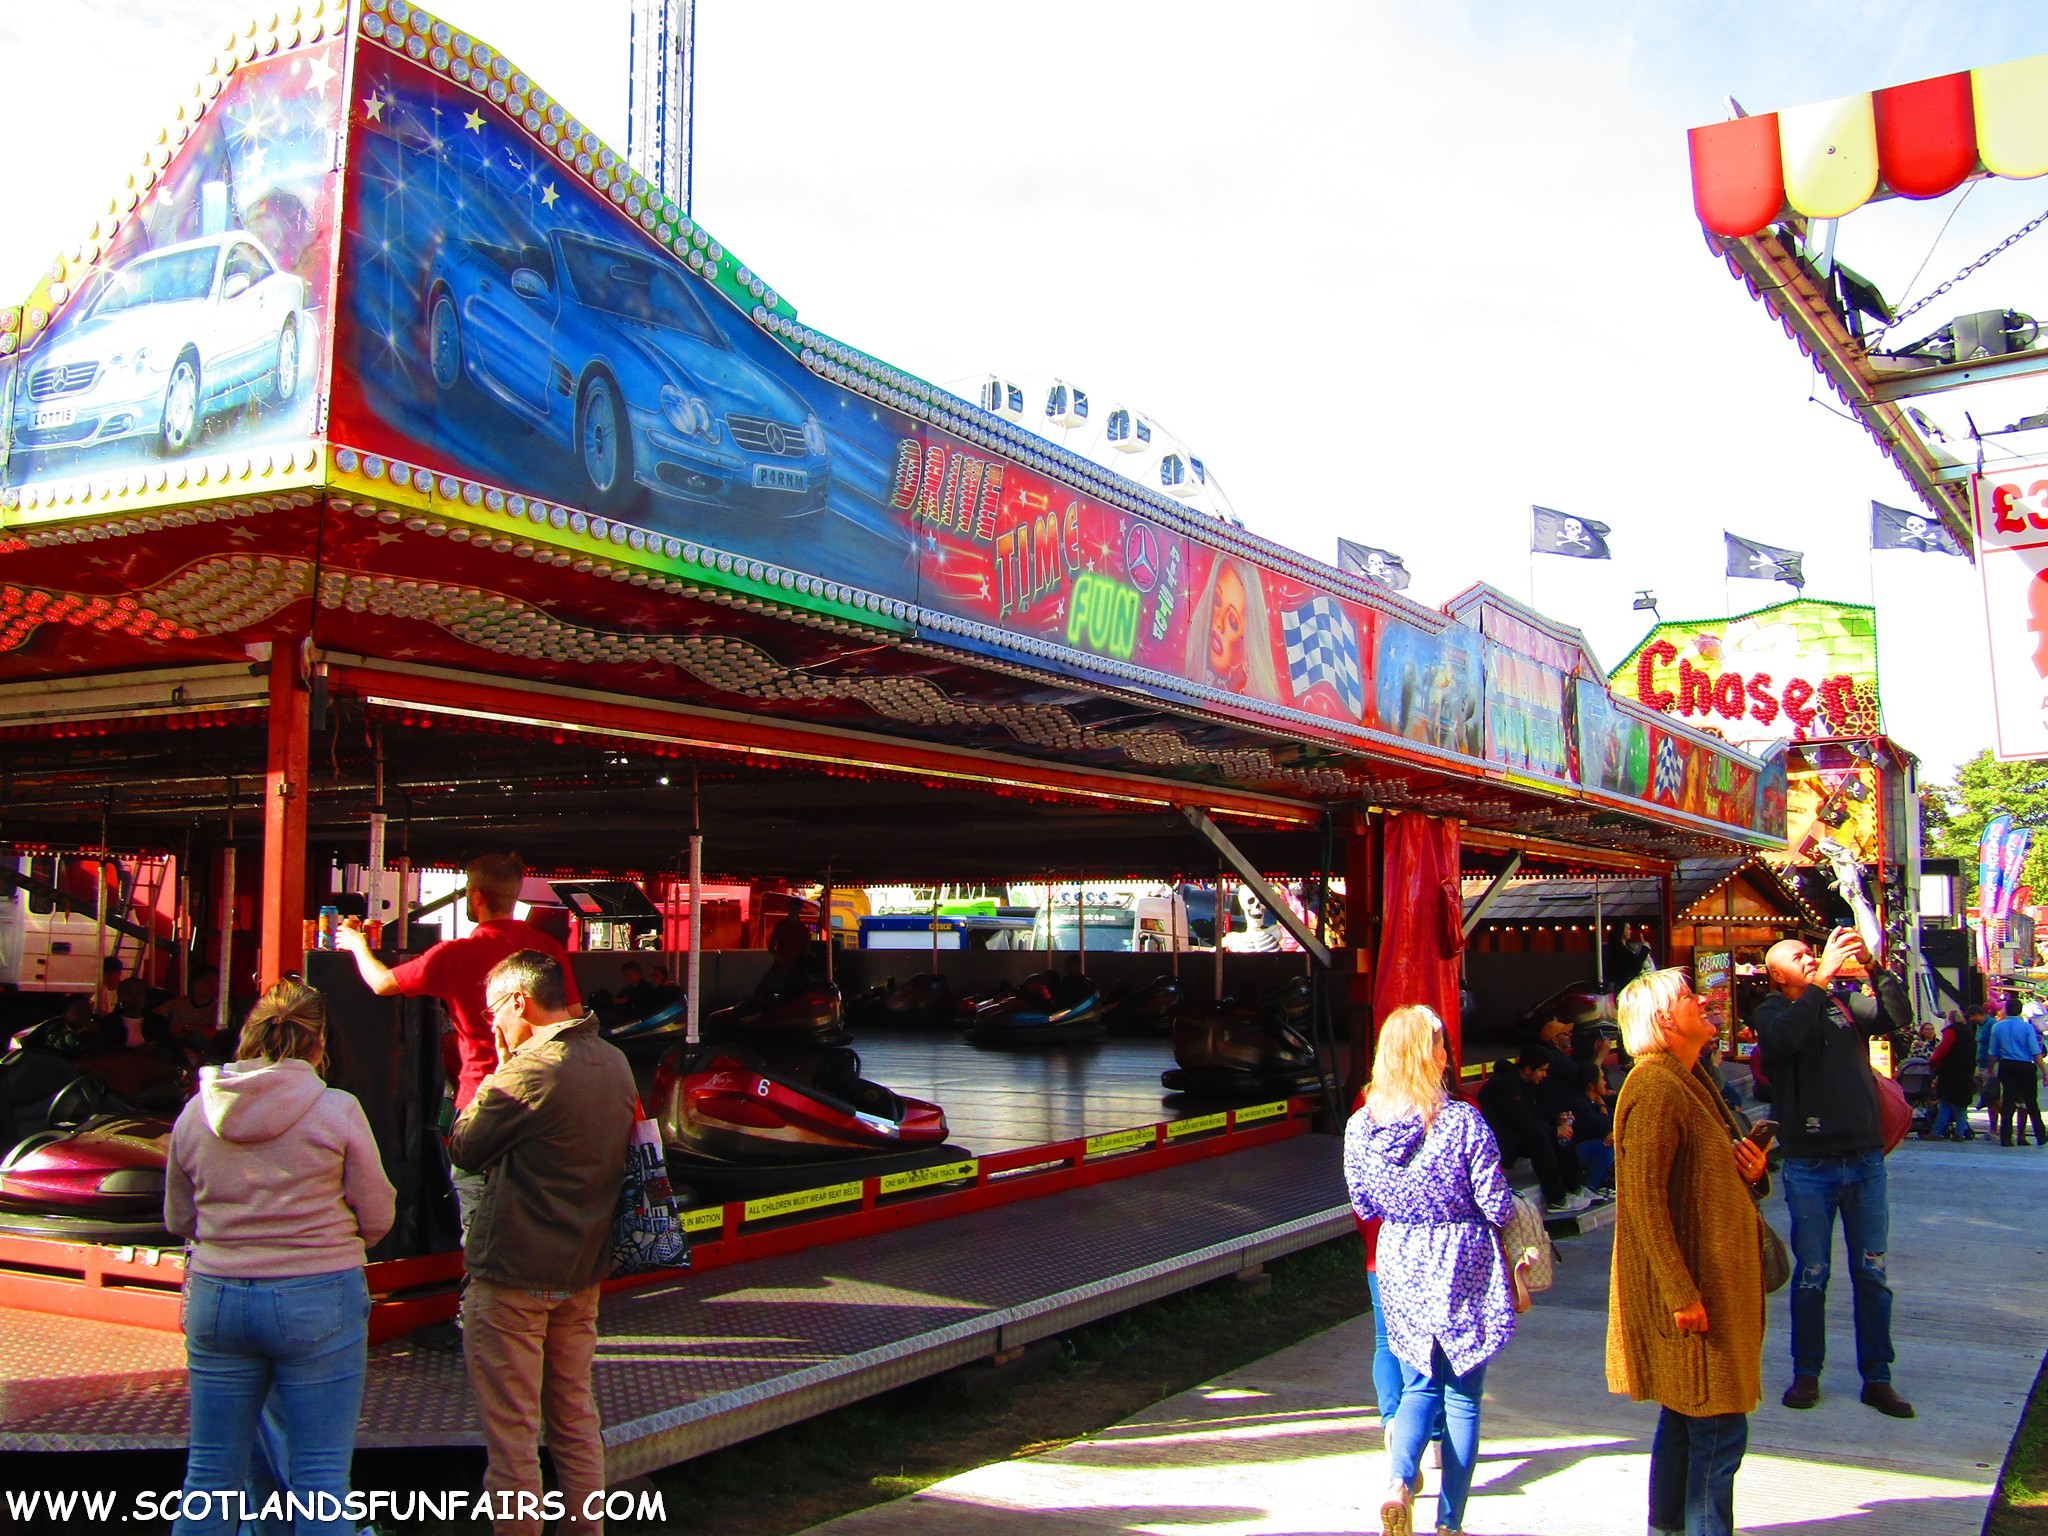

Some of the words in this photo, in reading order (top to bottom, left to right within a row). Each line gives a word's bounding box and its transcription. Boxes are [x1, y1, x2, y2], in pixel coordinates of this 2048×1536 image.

[34, 409, 72, 426] LOTTIE
[760, 468, 804, 489] P4RNM
[889, 437, 1005, 541] DRIVE
[995, 501, 1080, 610] TIME
[1067, 573, 1141, 659] FUN
[1636, 639, 1859, 738] Chaser
[1985, 833, 2000, 869] CANDY
[1698, 953, 1730, 973] CHURROS
[757, 1078, 771, 1097] 6
[884, 1180, 896, 1188] ONE
[897, 1177, 907, 1185] WAY
[908, 1173, 929, 1183] AROUND
[930, 1171, 939, 1179] THE
[940, 1169, 956, 1177] TRACK
[748, 1205, 761, 1215] ALL
[762, 1200, 792, 1213] CHILDREN
[793, 1195, 809, 1206] MUST
[810, 1192, 827, 1203] WEAR
[828, 1188, 843, 1200] SEAT
[843, 1186, 860, 1197] BELTS
[687, 1217, 694, 1226] IN
[695, 1213, 721, 1224] MOTION
